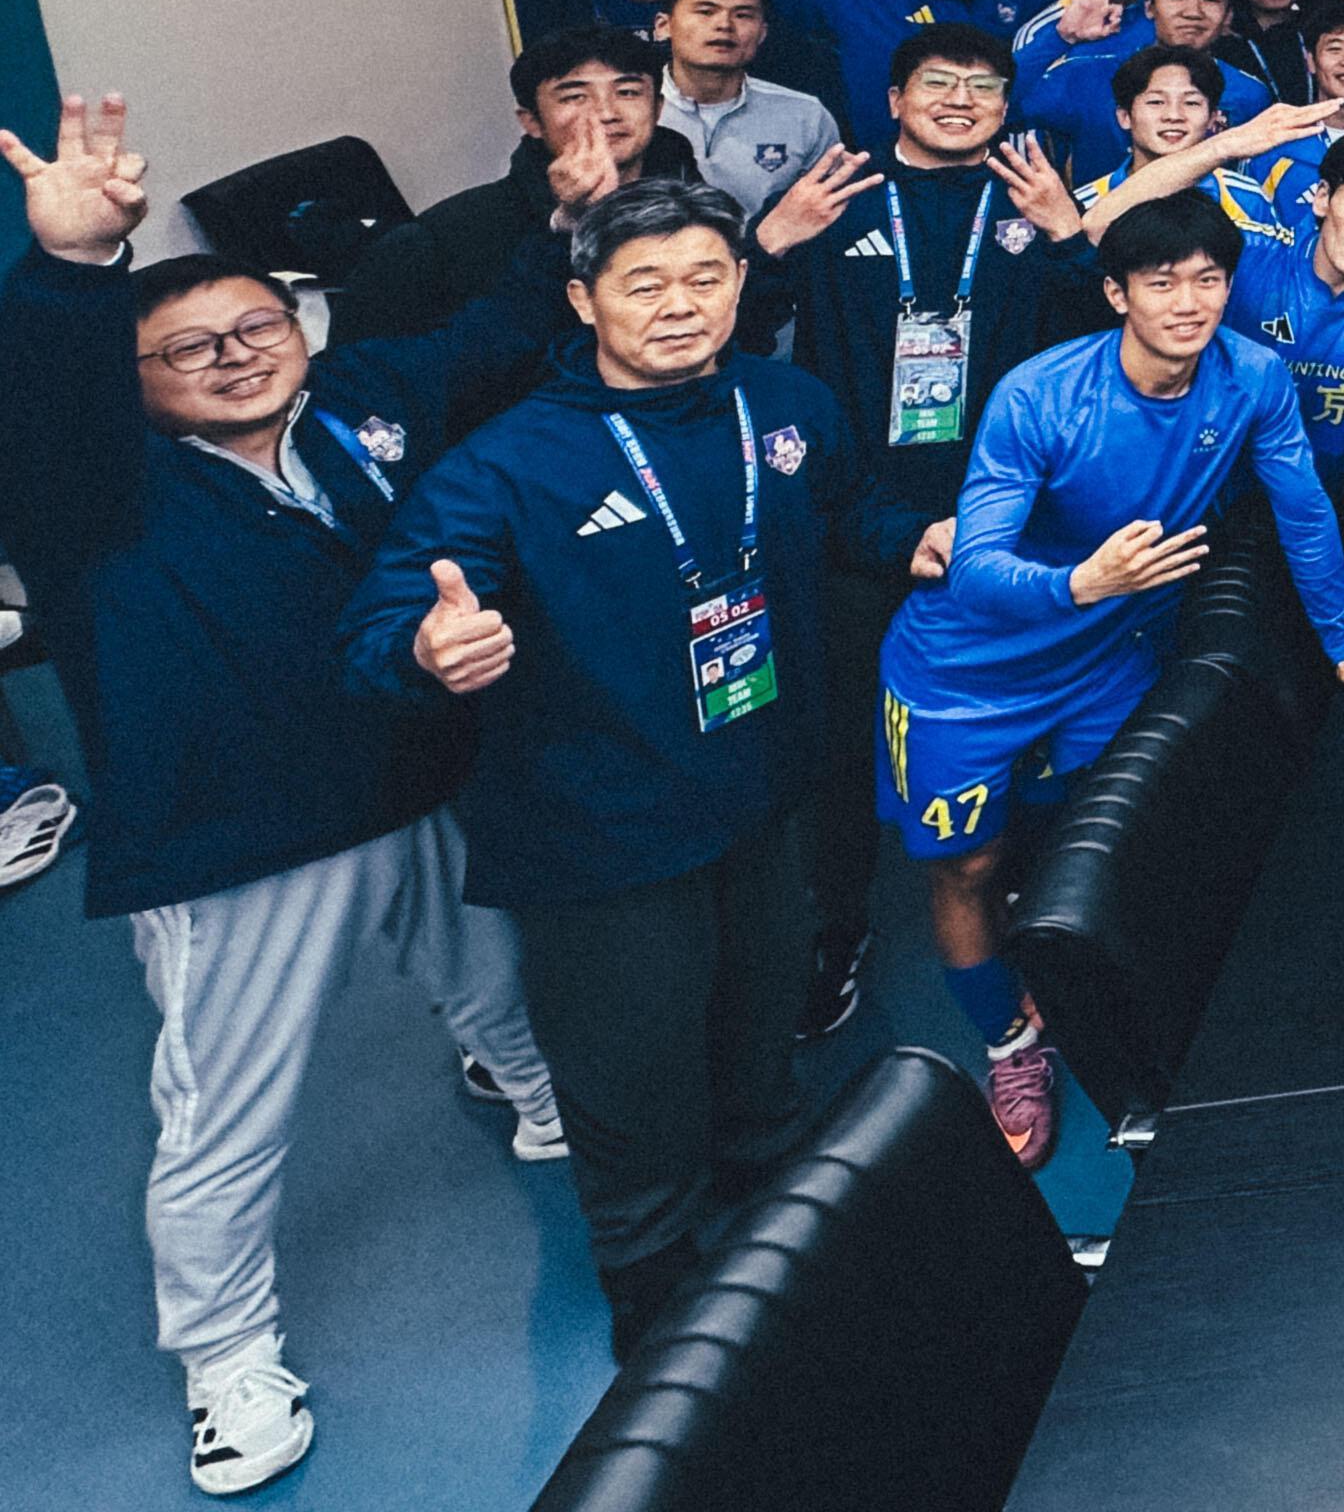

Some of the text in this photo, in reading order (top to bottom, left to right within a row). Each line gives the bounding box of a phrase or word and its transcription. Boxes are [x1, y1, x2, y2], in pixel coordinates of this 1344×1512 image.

[709, 600, 750, 628] 05 02
[921, 784, 990, 842] 47
